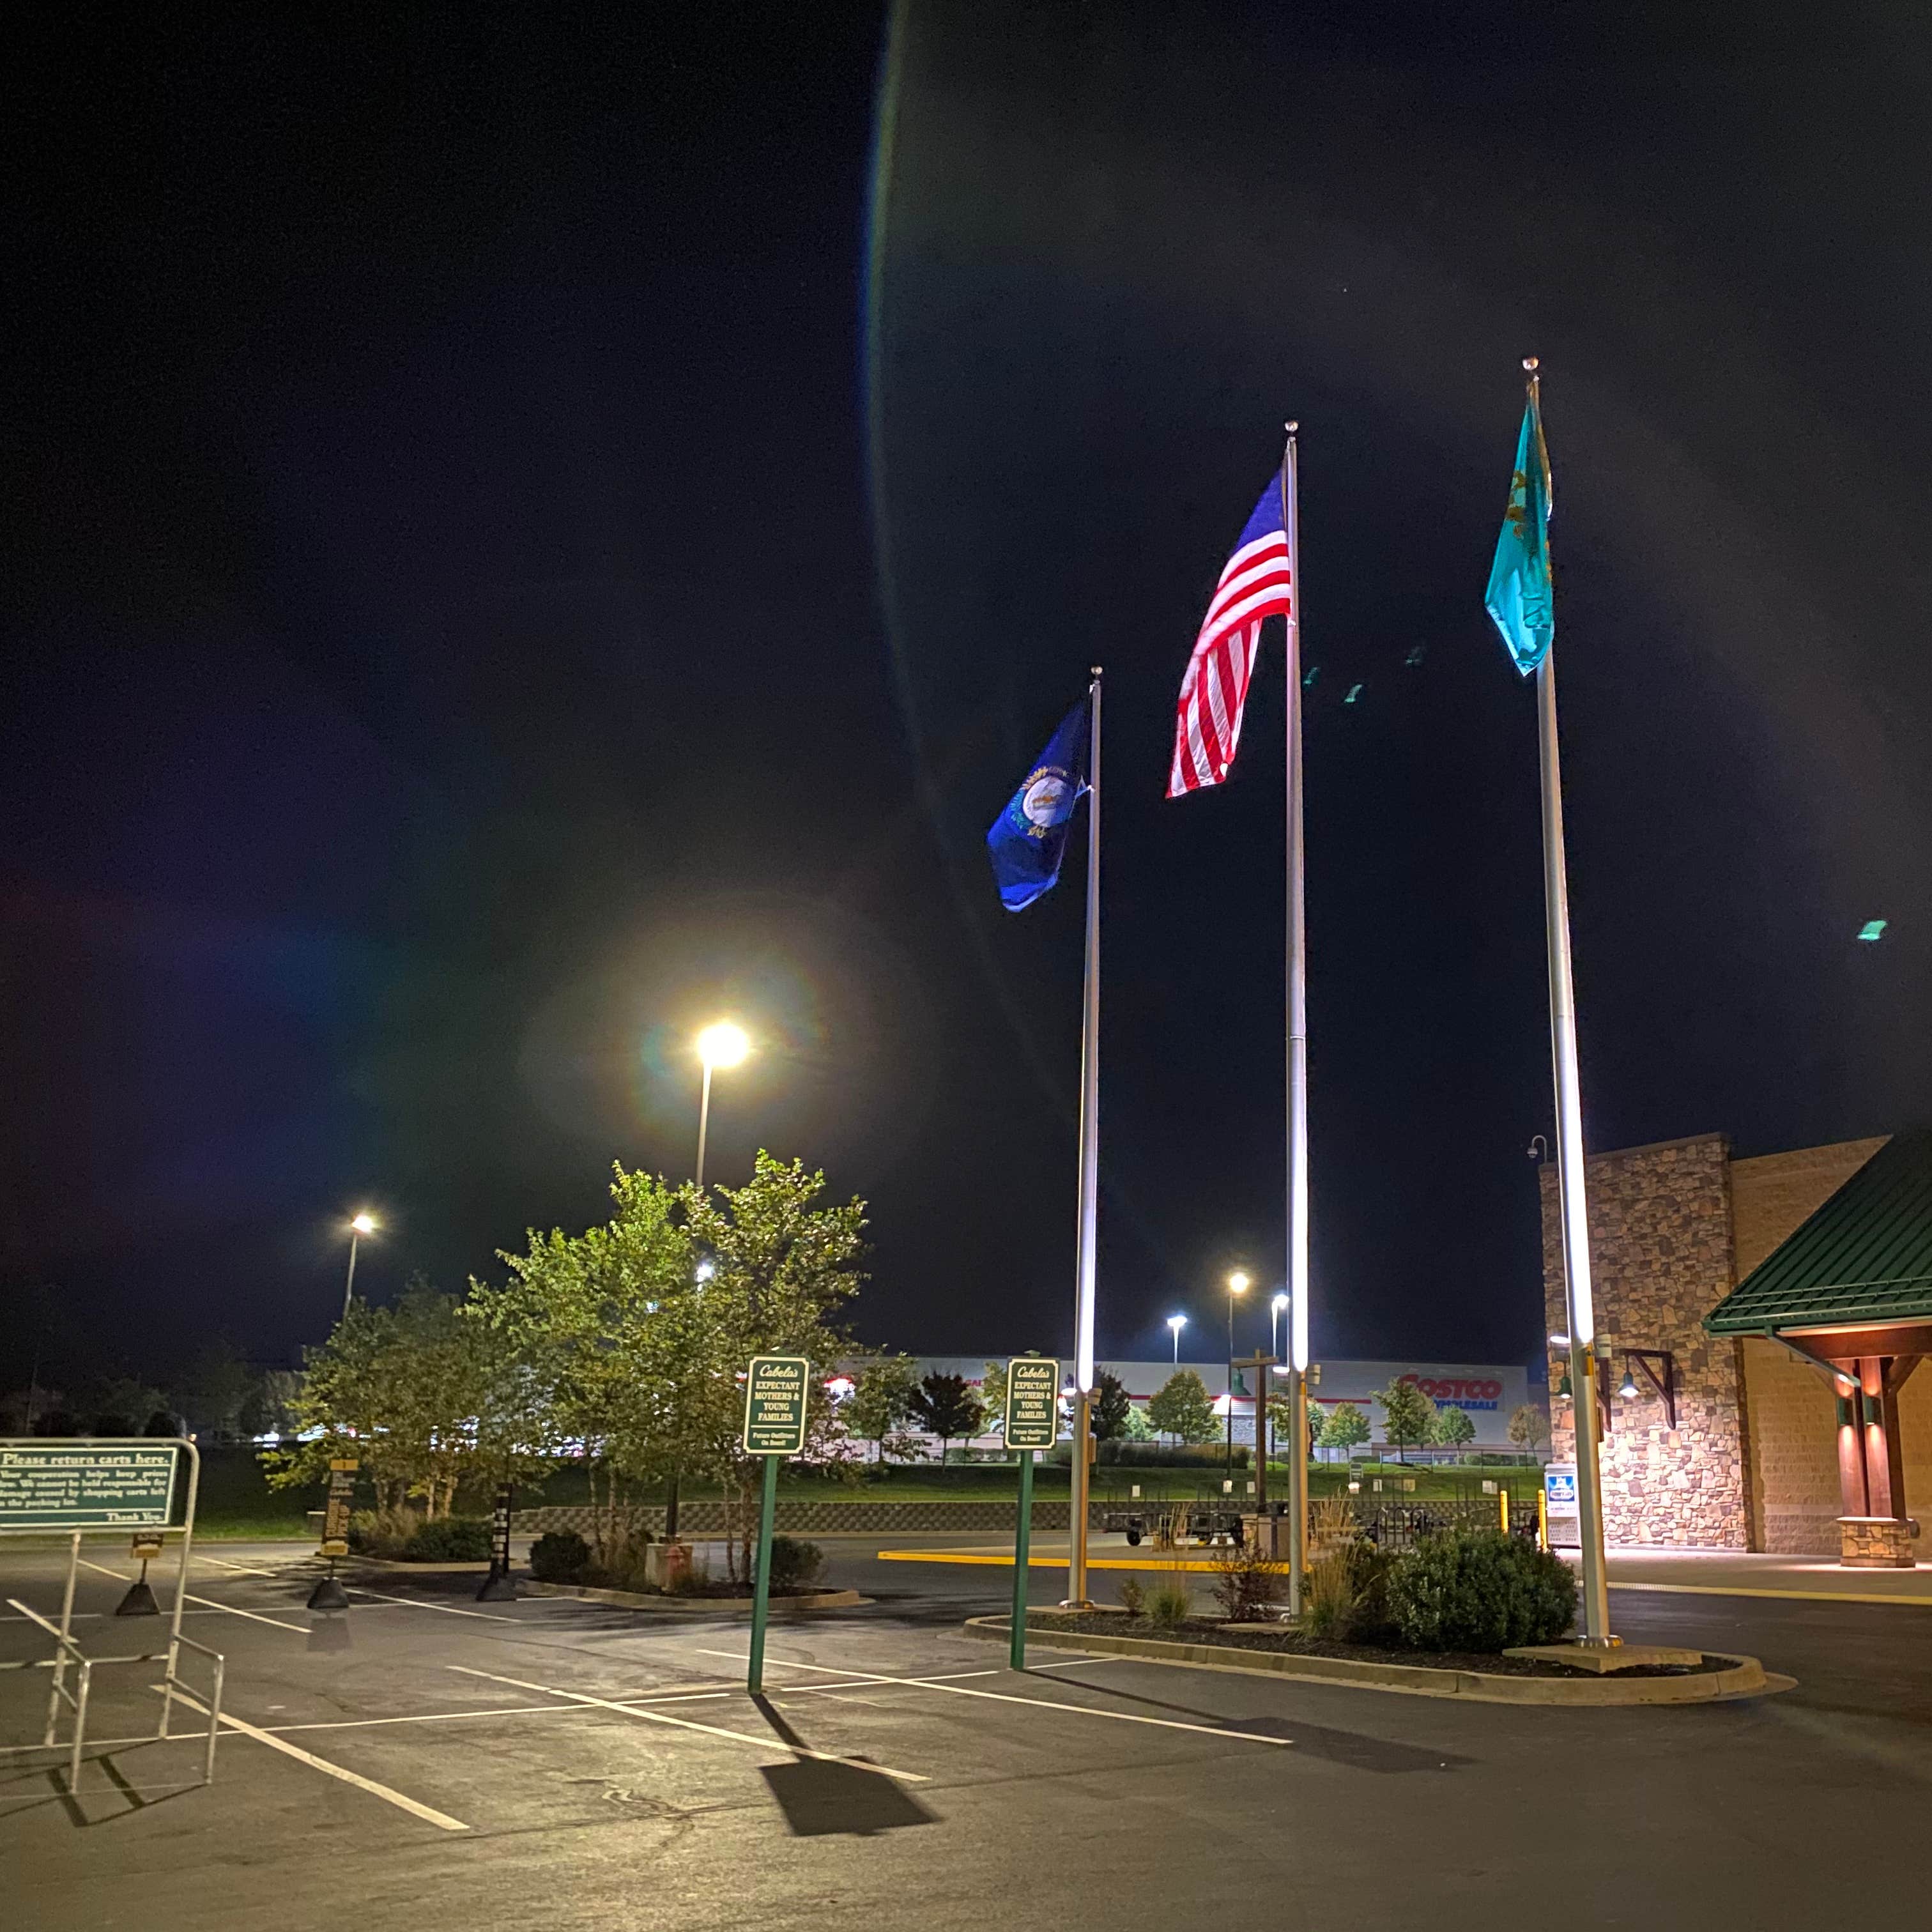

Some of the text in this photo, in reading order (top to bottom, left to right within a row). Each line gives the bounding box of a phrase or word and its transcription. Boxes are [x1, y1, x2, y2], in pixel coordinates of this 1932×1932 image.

[760, 1365, 798, 1377] Cabela's
[1017, 1366, 1050, 1379] Cabela's
[756, 1381, 800, 1390] EXPECTANT
[755, 1392, 792, 1400] MOTHERS
[763, 1402, 790, 1411] YOUNG
[3, 1453, 46, 1464] Please
[50, 1456, 95, 1464] return
[135, 1453, 169, 1464] here.
[106, 1512, 139, 1521] Thank
